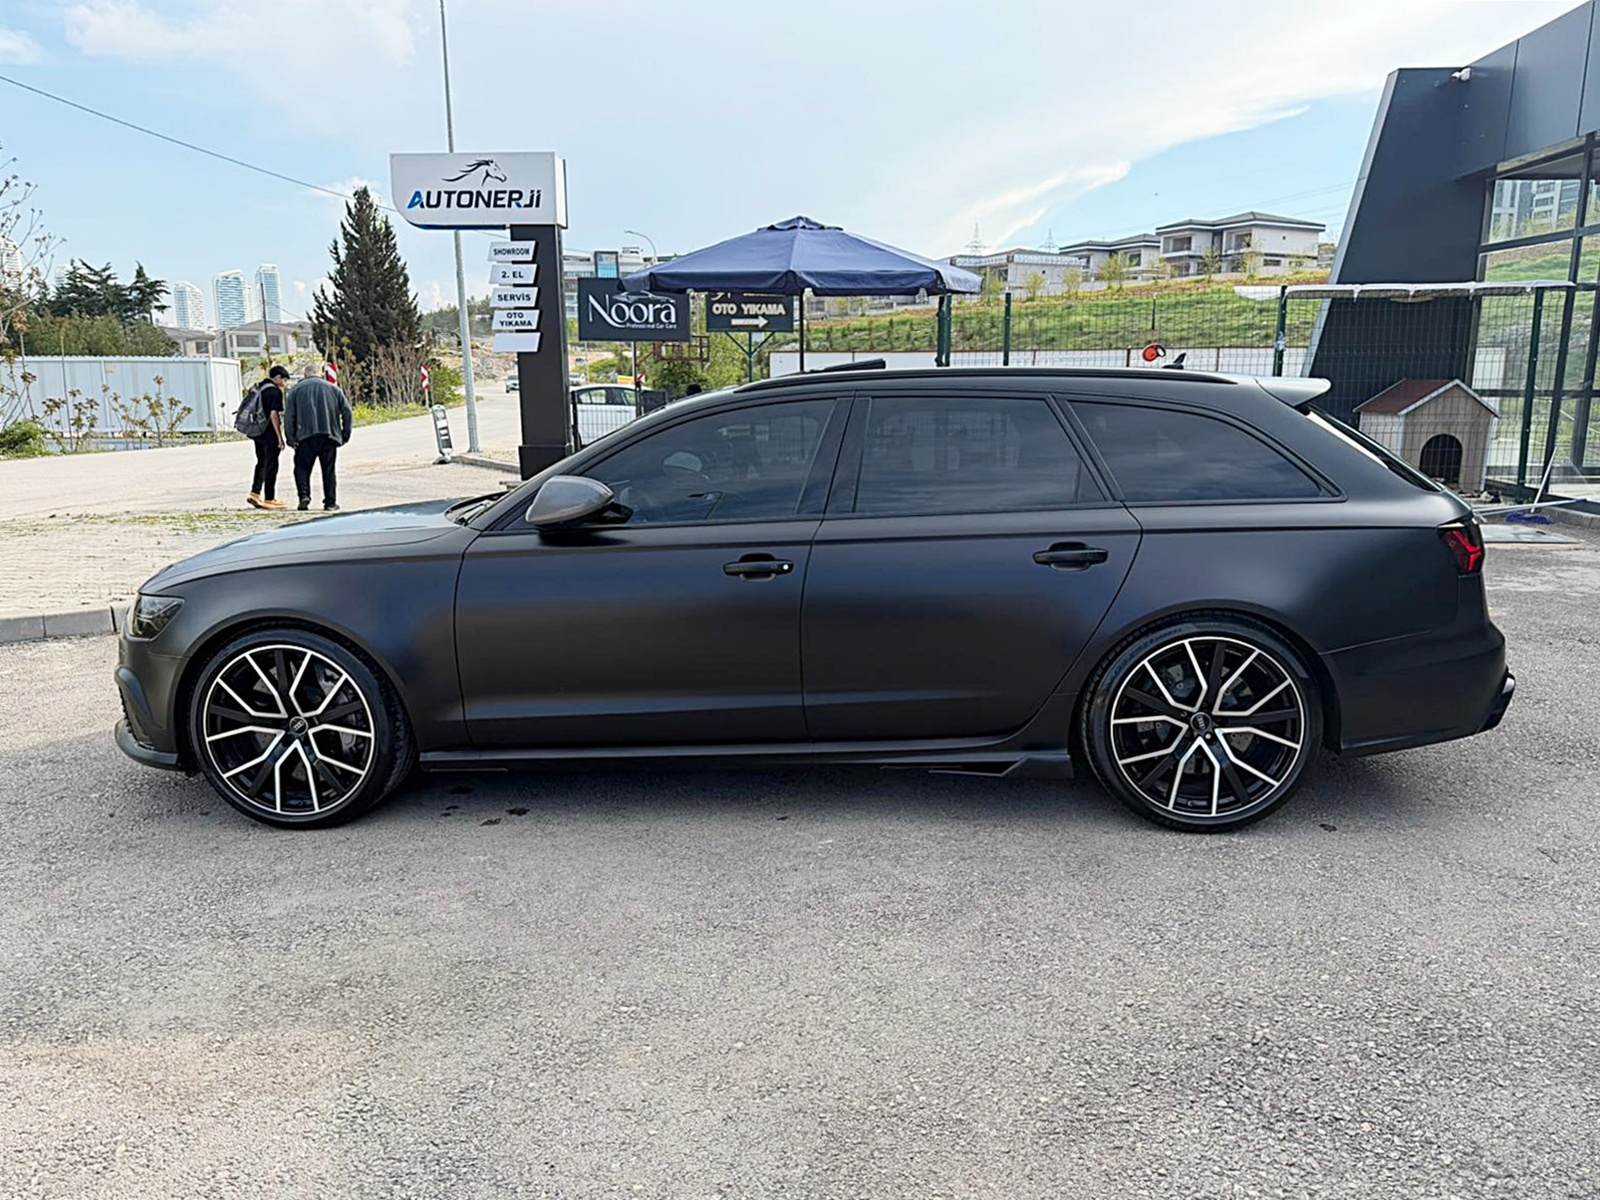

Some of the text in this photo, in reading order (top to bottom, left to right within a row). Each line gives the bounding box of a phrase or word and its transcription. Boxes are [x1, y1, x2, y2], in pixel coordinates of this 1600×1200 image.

[493, 247, 530, 256] SHOWROOM
[501, 270, 524, 279] 2. EL
[588, 293, 677, 328] Noora
[712, 303, 786, 316] OTO YIKAMA
[499, 320, 533, 328] YIKAMA
